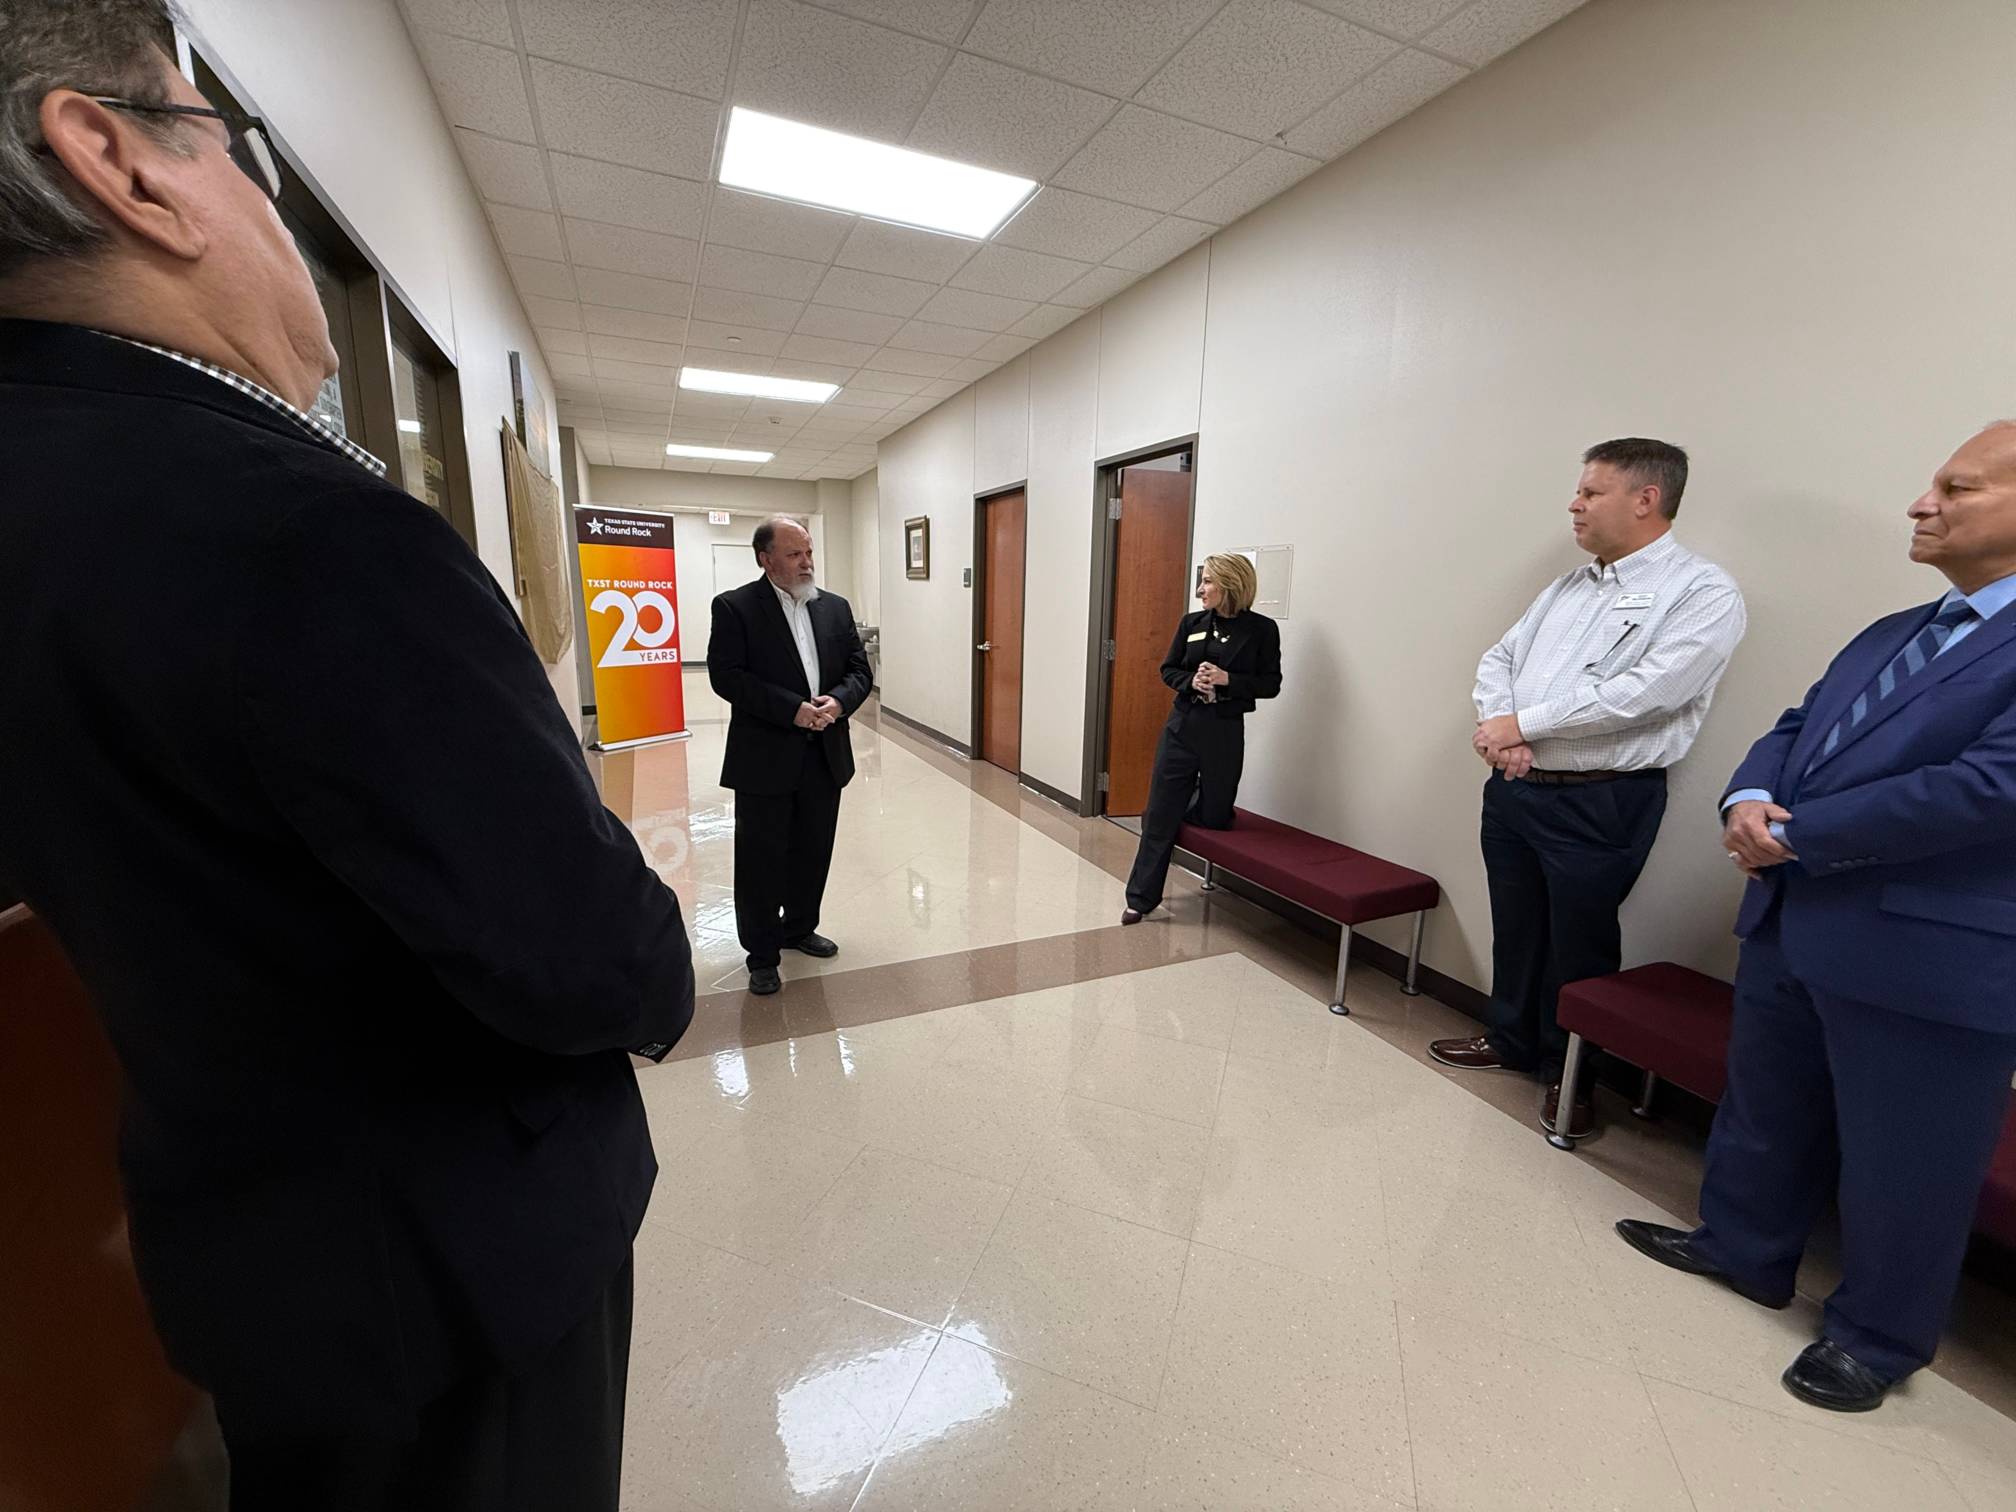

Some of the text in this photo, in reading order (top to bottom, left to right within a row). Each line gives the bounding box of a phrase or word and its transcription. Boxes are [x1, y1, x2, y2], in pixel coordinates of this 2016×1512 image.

[637, 521, 665, 529] UNIVERSITY
[604, 525, 652, 537] Round Rock
[587, 579, 673, 589] TXST ROUND ROCK
[590, 590, 677, 668] 20
[639, 651, 675, 662] YEARS
